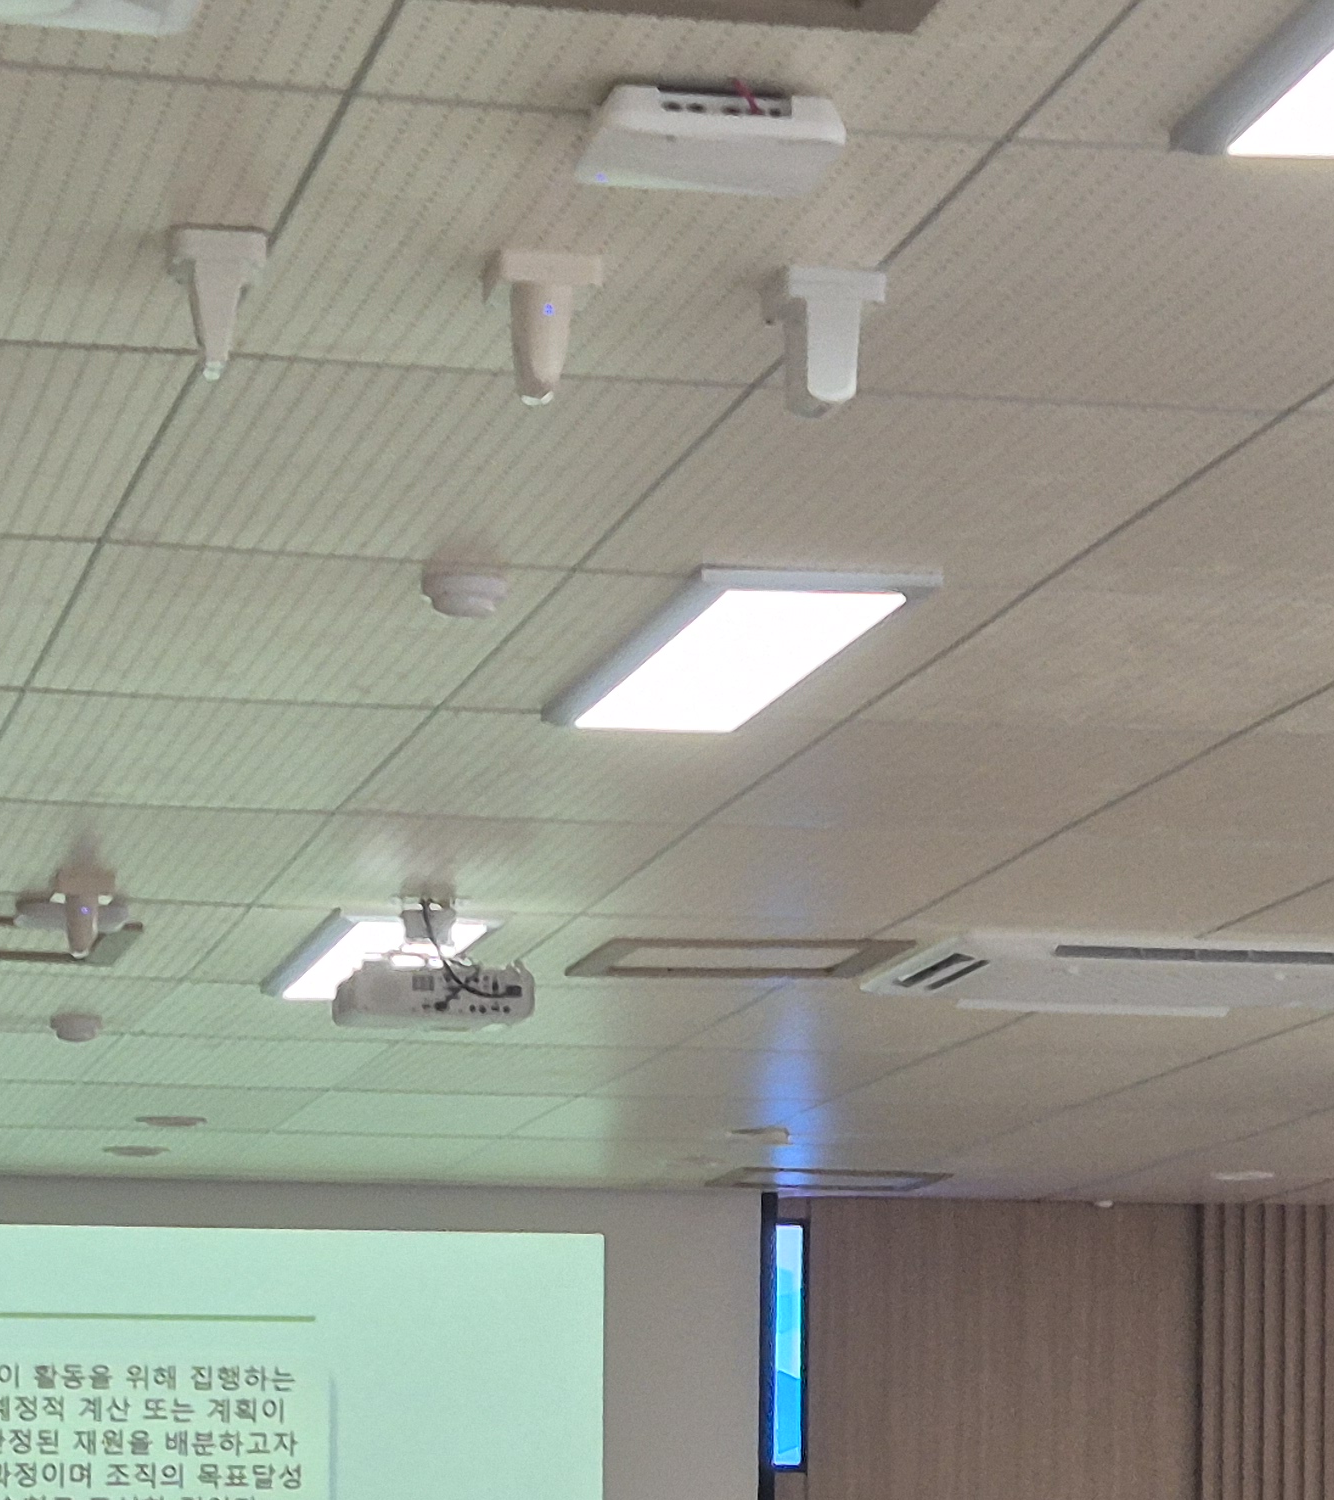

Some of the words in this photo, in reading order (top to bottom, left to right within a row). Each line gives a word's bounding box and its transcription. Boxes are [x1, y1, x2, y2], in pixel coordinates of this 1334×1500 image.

[34, 1363, 113, 1391] 활동을
[126, 1364, 177, 1391] 위해
[190, 1365, 296, 1392] 집행하는
[79, 1396, 131, 1423] 계산
[143, 1397, 195, 1423] 또는
[207, 1397, 285, 1424] 계획이
[73, 1429, 153, 1456] 재원을
[165, 1430, 299, 1458] 배분하고자
[105, 1462, 184, 1490] 조직의
[197, 1463, 303, 1491] 목표달성
